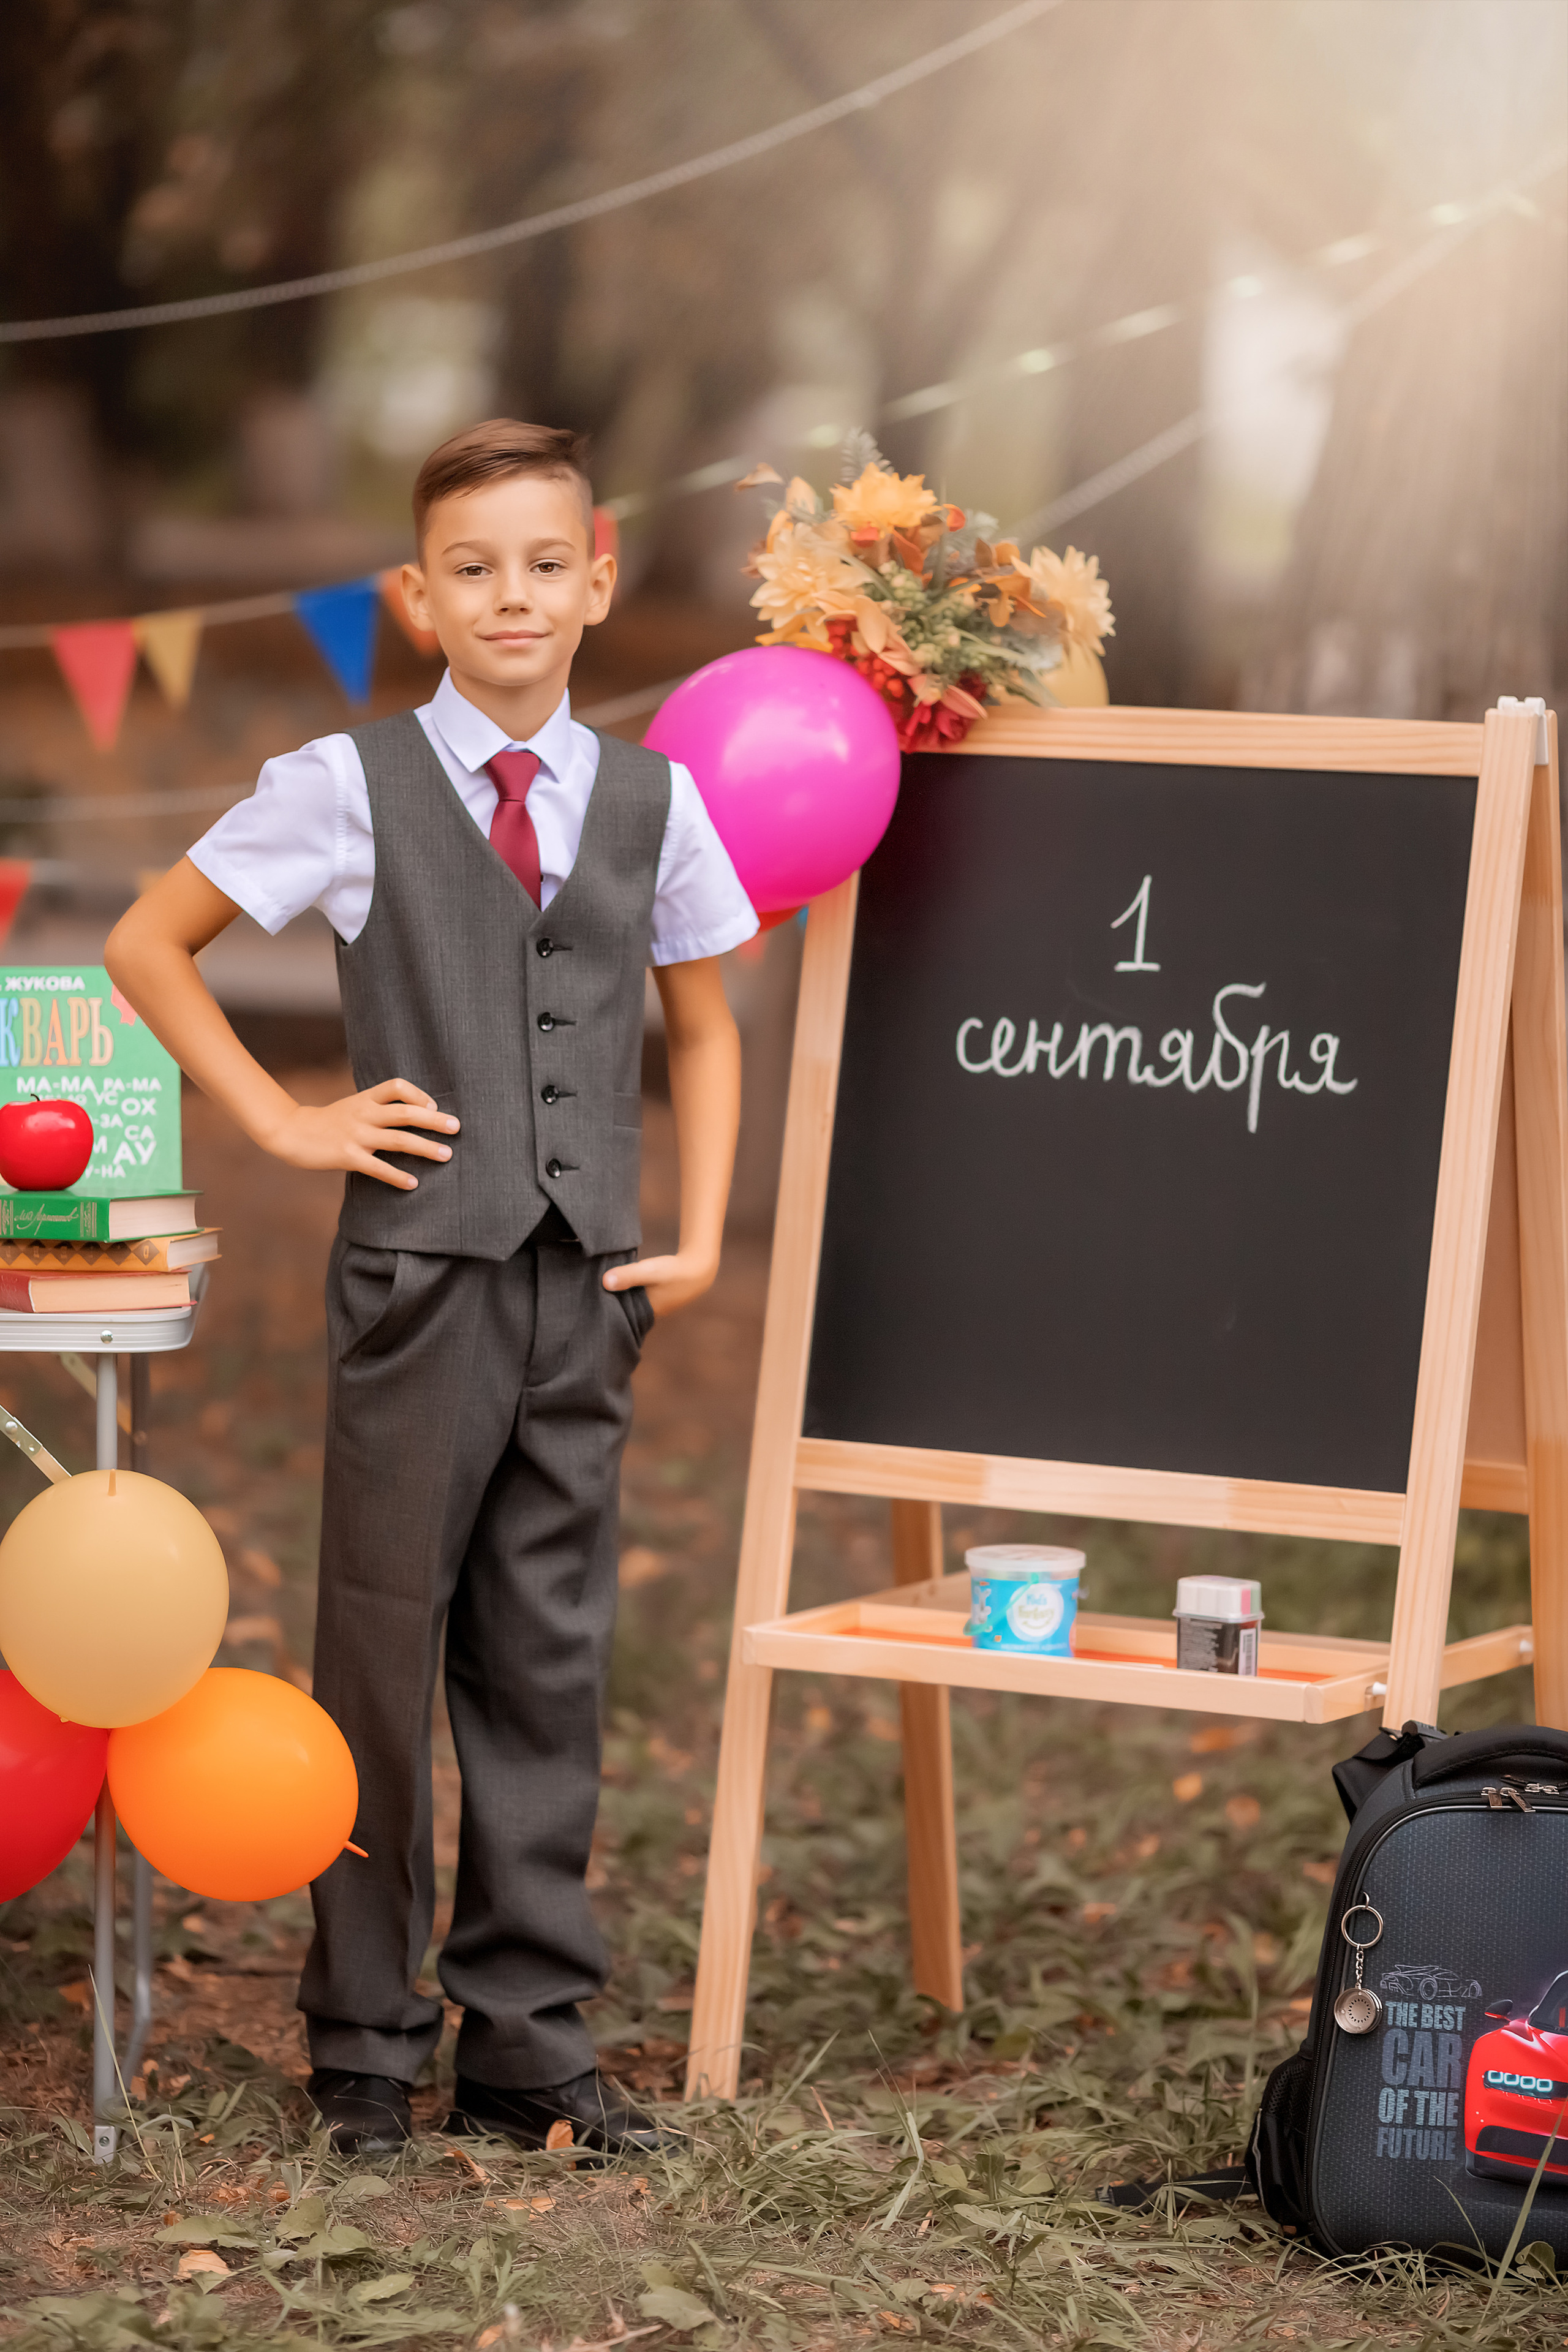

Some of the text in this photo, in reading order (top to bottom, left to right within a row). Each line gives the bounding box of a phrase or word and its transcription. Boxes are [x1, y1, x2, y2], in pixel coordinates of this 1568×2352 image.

[1110, 874, 1161, 972] 1
[5, 975, 86, 992] ЖУКОВА
[956, 982, 1358, 1133] сентября
[121, 1097, 157, 1116] ОХ
[124, 1125, 154, 1140] СА
[112, 1140, 157, 1166] АУ
[1385, 2000, 1466, 2031] THE BEST
[1381, 2028, 1463, 2089] CAR
[1378, 2087, 1460, 2127] OF THE
[1376, 2126, 1457, 2161] FUTURE
